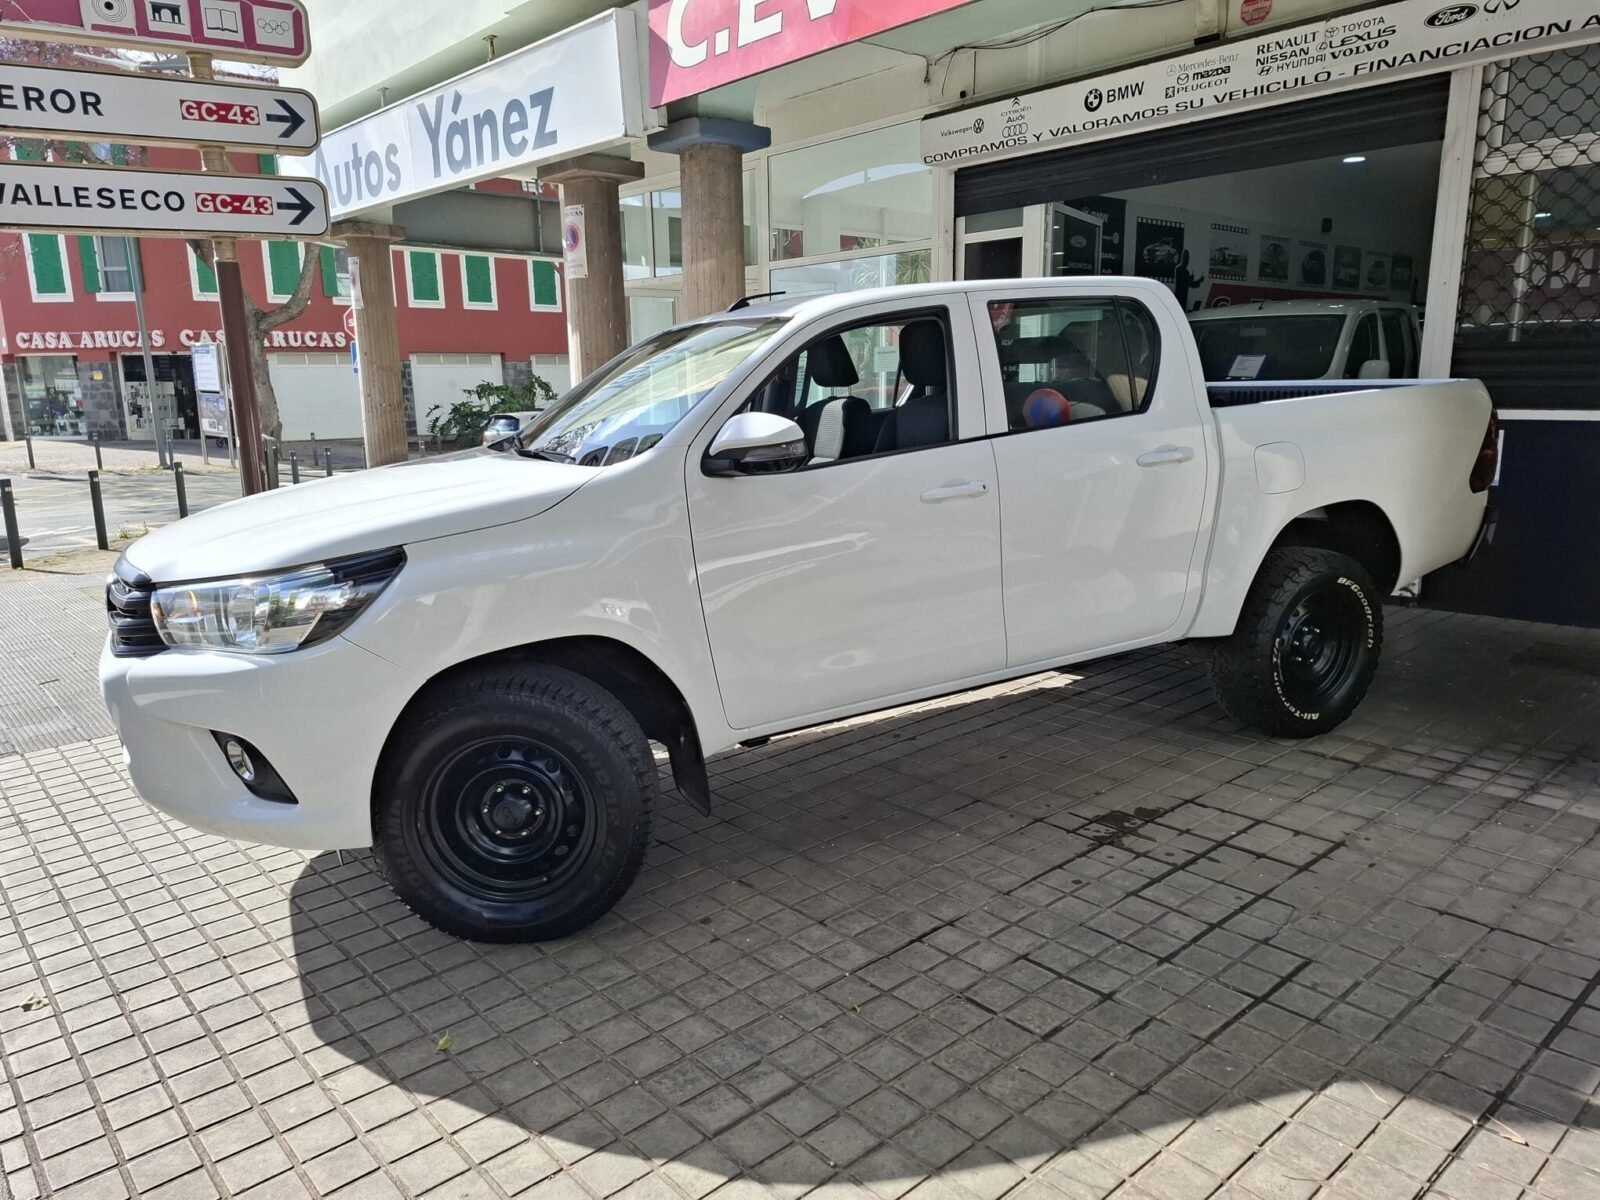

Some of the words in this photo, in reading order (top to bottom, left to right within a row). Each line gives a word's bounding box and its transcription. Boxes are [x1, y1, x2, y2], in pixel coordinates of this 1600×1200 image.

[1434, 7, 1469, 26] Ford
[667, 0, 837, 68] C.E
[1256, 31, 1319, 55] RENAULT
[1342, 16, 1386, 33] TOYOTA
[1255, 47, 1310, 67] NISSAN
[1328, 25, 1397, 48] LEXUS
[1276, 54, 1327, 72] HYUNDAI
[1331, 39, 1390, 60] VOLVO
[1192, 65, 1232, 81] mazda
[923, 136, 1028, 165] COMPRAMOS
[1032, 132, 1044, 143] Y
[1049, 105, 1169, 137] VALORAMOS
[1175, 97, 1204, 112] SU
[1213, 70, 1332, 104] VEHICULO
[1353, 20, 1572, 76] FINANCIACION
[1106, 81, 1145, 104] BMW
[1176, 77, 1230, 94] PEUGEOT
[0, 84, 105, 117] EROR
[181, 100, 260, 126] GC-43
[1006, 114, 1026, 125] Audi
[940, 126, 973, 137] Volkswagen
[313, 143, 402, 211] Autos
[416, 86, 559, 179] Yánez
[196, 193, 273, 216] GC-43
[16, 331, 74, 349] CASA
[180, 328, 225, 346] CAS
